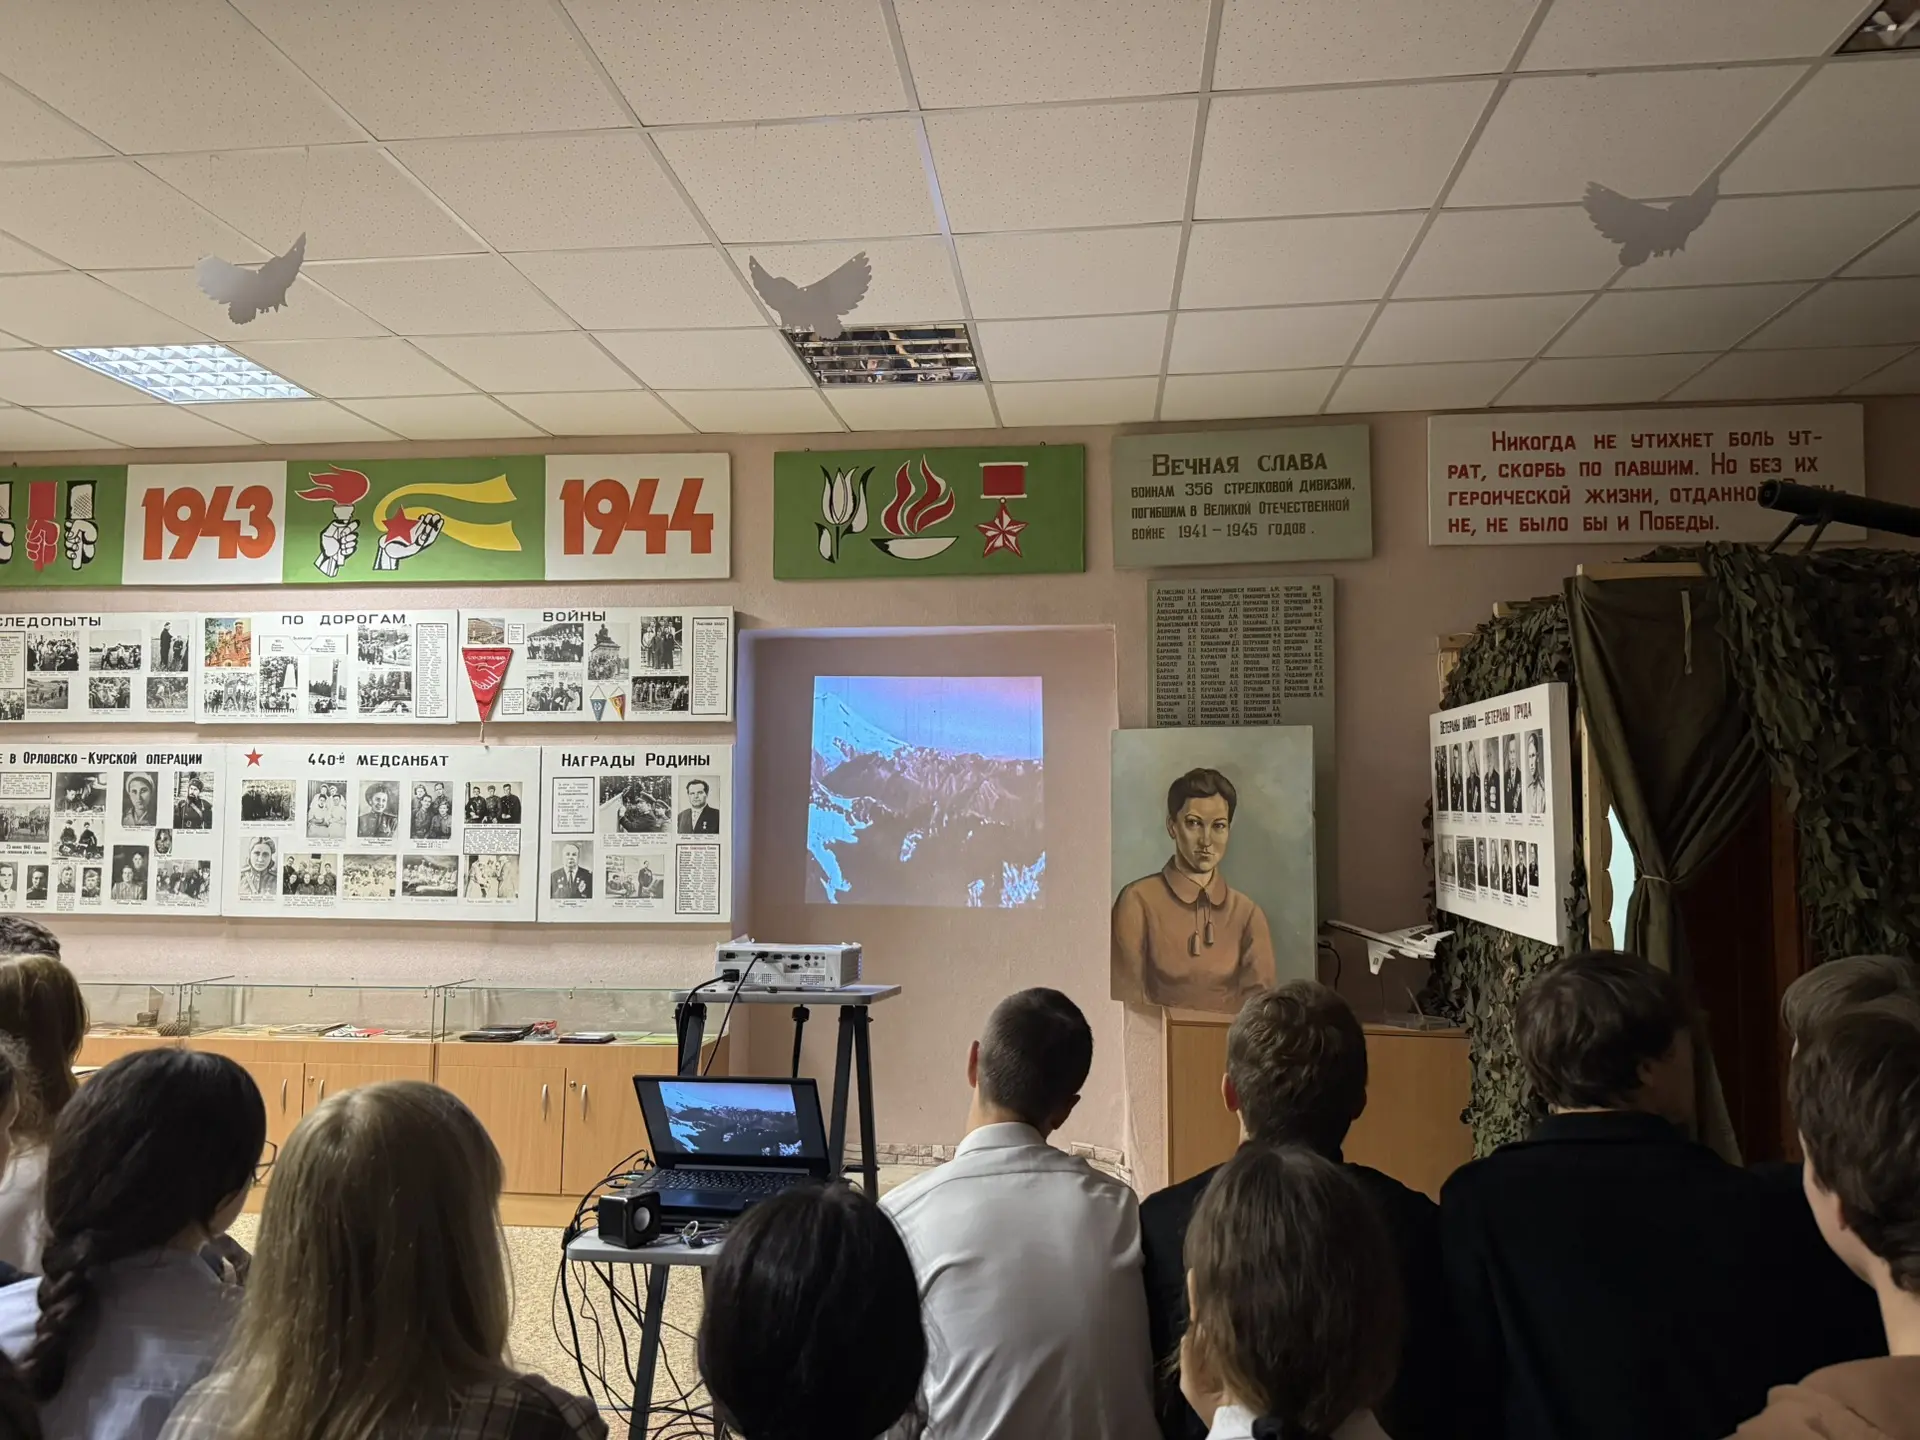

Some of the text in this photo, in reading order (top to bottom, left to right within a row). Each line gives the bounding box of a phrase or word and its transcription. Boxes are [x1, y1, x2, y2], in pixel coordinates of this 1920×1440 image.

[1493, 431, 1822, 452] НИКОГДА НЕ УТИХНЕТ БОЛЬ УТ-
[1152, 453, 1327, 476] ВЕЧНАЯ СЛАВА
[1448, 452, 1818, 481] РАТ, СКОРБЬ ПО ПАВШИМ. НО БЕЗ ИХ
[1132, 486, 1174, 498] ВОИНАМ
[1185, 483, 1212, 496] 356
[1225, 478, 1292, 494] СТРЕЛКОВОЙ
[1449, 485, 1763, 506] ГЕРОИЧЕСКОЙ ЖИЗНИ, ОТДАННО
[560, 478, 713, 554] 1944
[1132, 497, 1349, 518] ПОГИБШИМ В ВЕЛИКОЙ ОТЕЧЕСТВЕННОЙ
[141, 485, 275, 560] 1943
[1132, 526, 1164, 540] ВОЙНЕ
[1179, 524, 1206, 538] 1941
[1228, 523, 1257, 536] 1945
[1449, 511, 1719, 536] НЕ, НЕ БЫЛО БЫ И ПОБЕДЫ.
[0, 617, 100, 628] ЛЕДОПЫТЫ
[282, 614, 406, 627] ПО ДОРОГАМ
[543, 610, 606, 623] ВОЙНЫ
[1440, 720, 1460, 734] ВЕТЕРАНЫ
[1463, 715, 1476, 730] ВОЙНЫ
[1485, 707, 1510, 725] ВЕТЕРАНЫ
[1514, 702, 1531, 719] ТРУДА
[10, 754, 16, 764] В
[147, 754, 202, 766] ОПЕРАЦИИ
[357, 755, 448, 767] МЕДСАНБАТ
[562, 753, 709, 768] НАГРАДЫ РОДИНЫ
